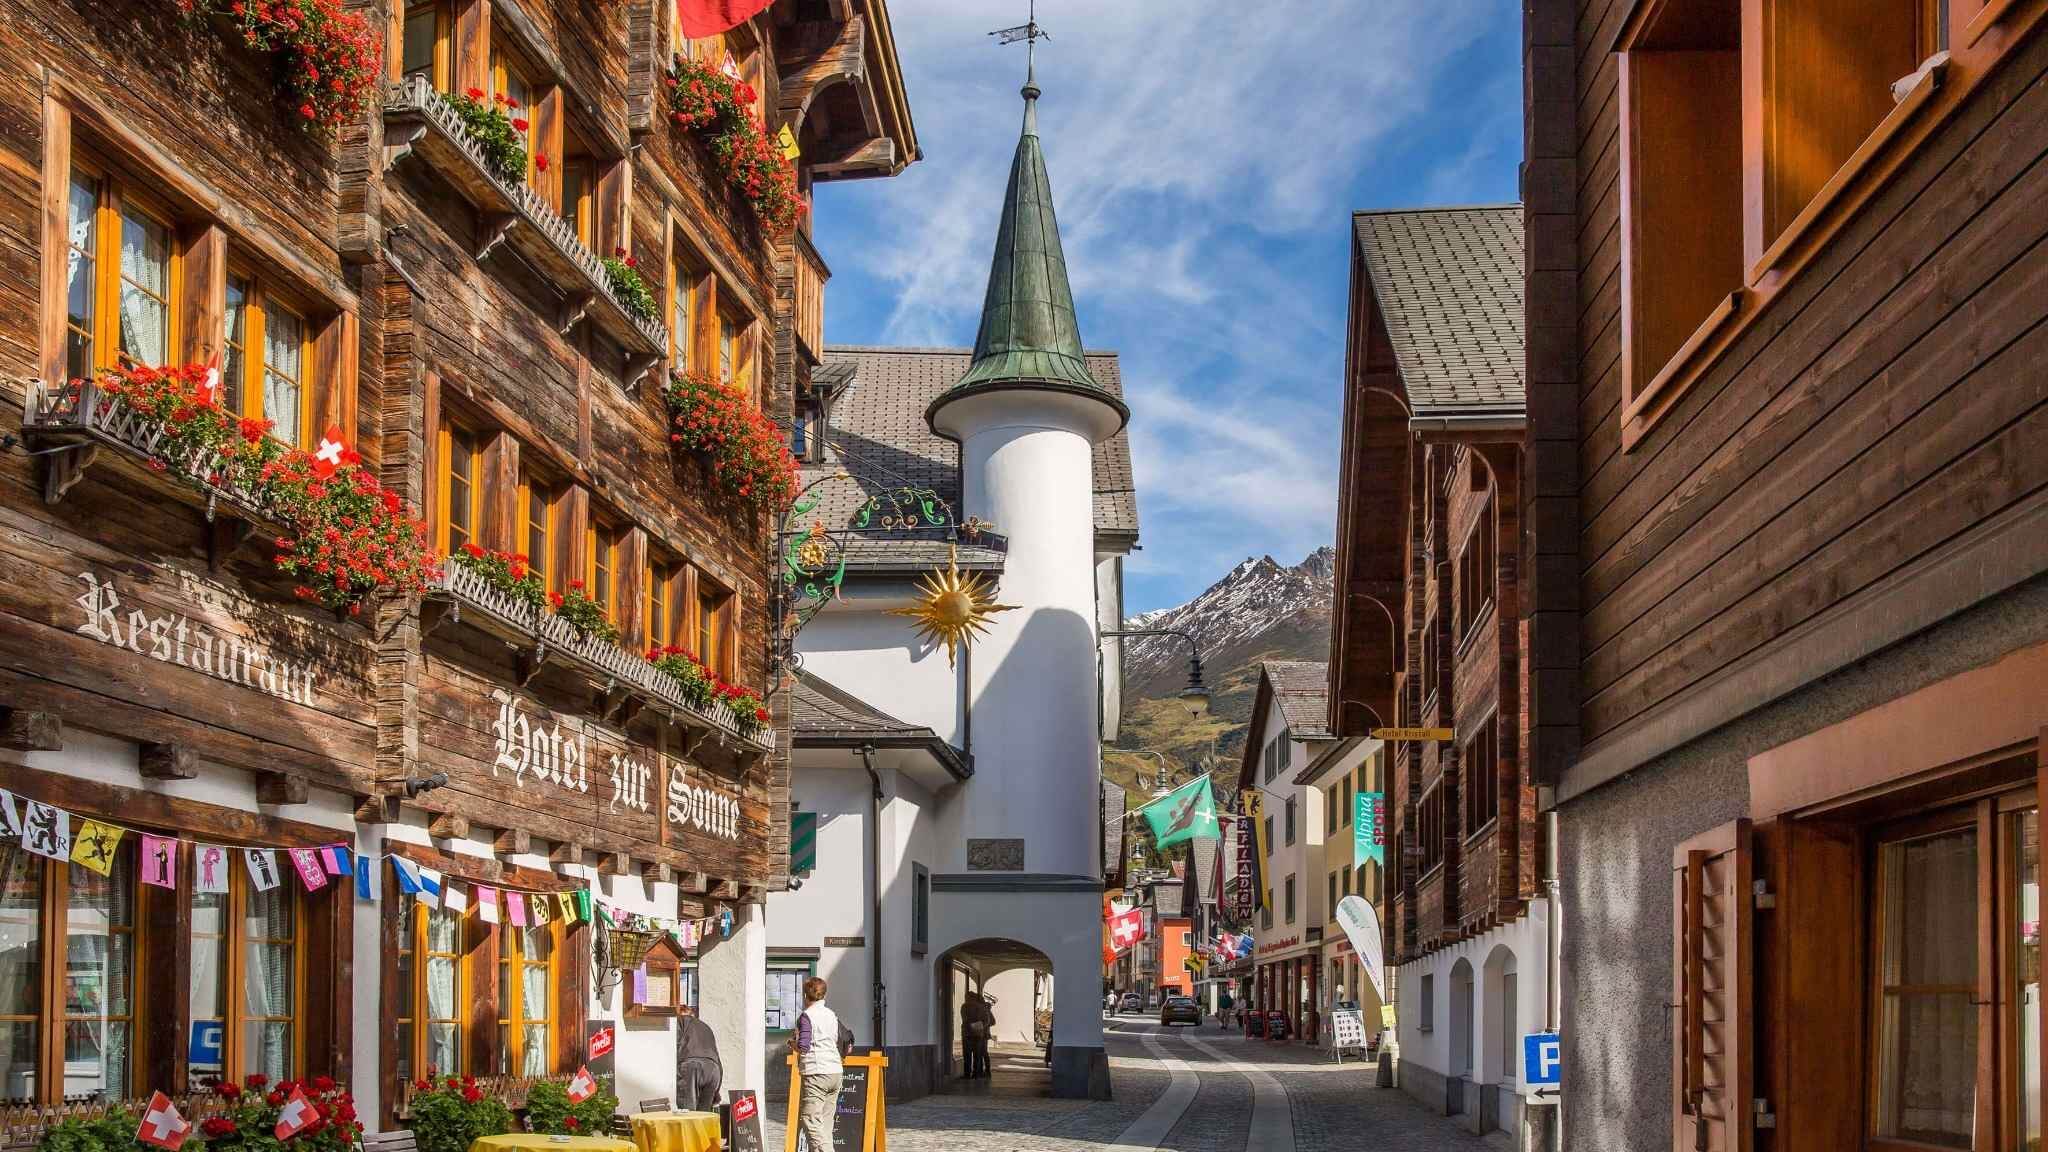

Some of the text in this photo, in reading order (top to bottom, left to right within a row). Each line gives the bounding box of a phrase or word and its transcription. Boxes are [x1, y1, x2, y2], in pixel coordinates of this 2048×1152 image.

[75, 571, 316, 706] Restaurant
[492, 689, 740, 840] Hotel zur Sonne
[1357, 796, 1373, 849] Alpina
[1539, 1041, 1561, 1078] P
